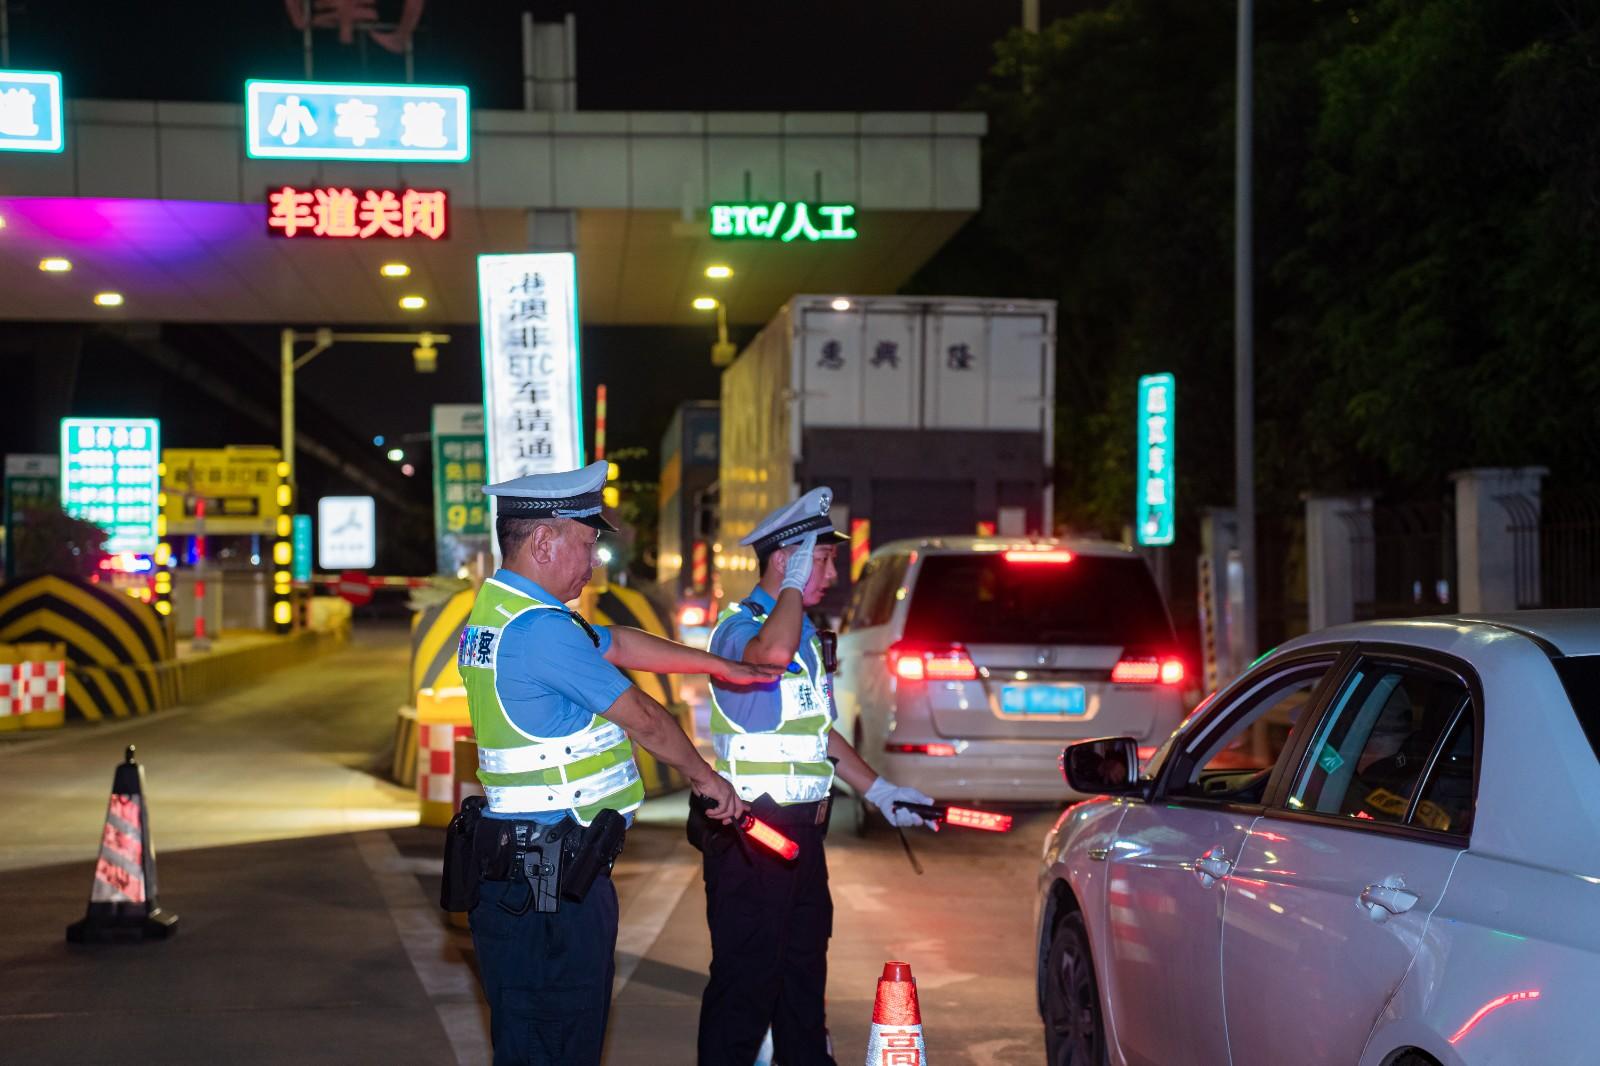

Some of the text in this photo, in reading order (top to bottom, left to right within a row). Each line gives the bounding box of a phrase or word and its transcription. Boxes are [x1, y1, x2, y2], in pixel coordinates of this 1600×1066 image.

[267, 95, 448, 148] 小车道
[268, 186, 447, 240] 车道关闭
